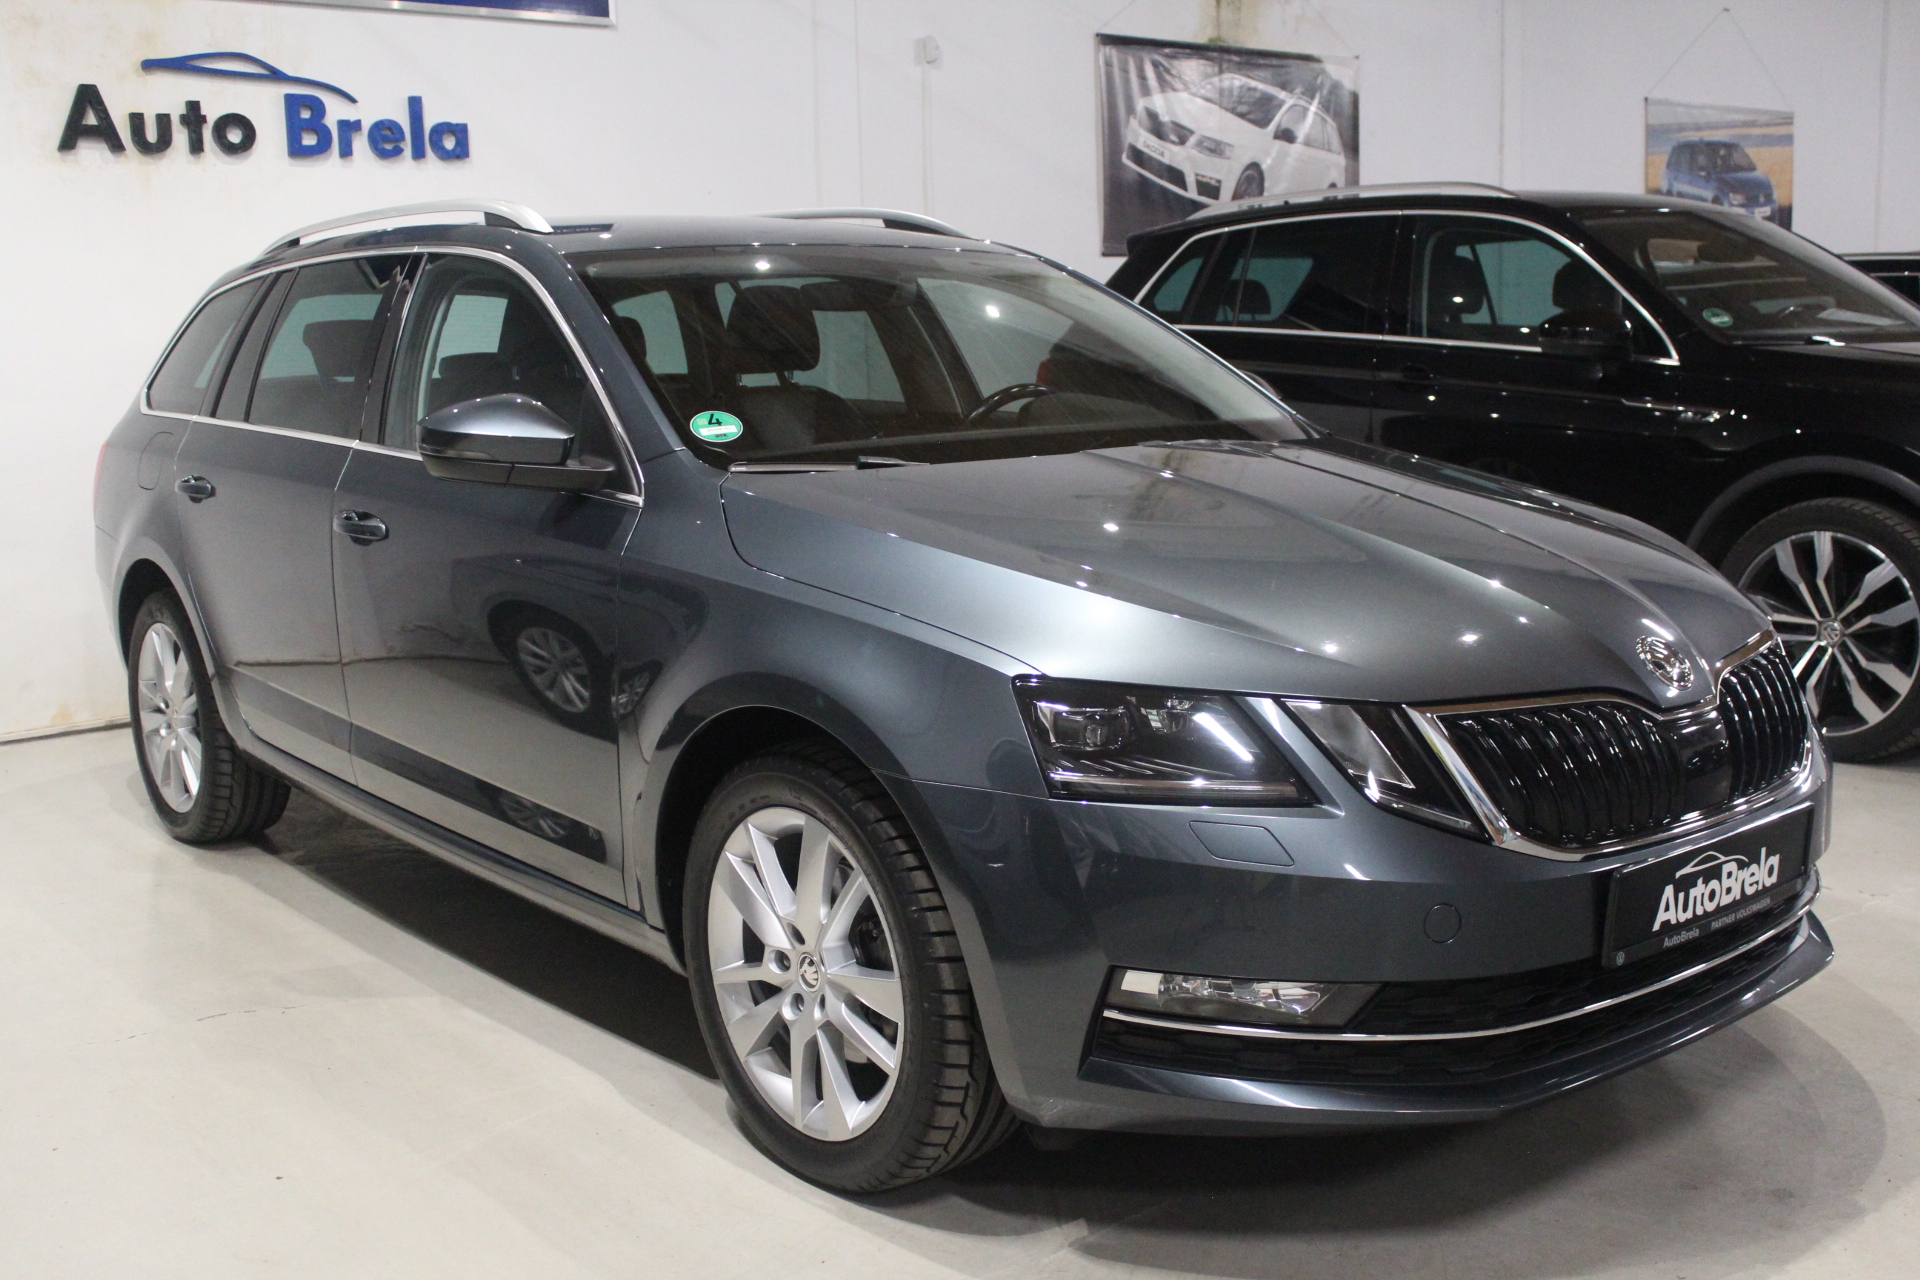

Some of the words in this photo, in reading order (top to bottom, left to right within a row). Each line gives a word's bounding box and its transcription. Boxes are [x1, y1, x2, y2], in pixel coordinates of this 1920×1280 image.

[57, 83, 257, 156] Auto
[284, 93, 471, 161] Brela
[708, 413, 722, 426] 4
[1652, 847, 1781, 932] AutoBrela
[1663, 927, 1699, 948] AutoBrela
[1711, 912, 1736, 930] PARTNER
[1736, 896, 1771, 919] VOLKSWAGEN
